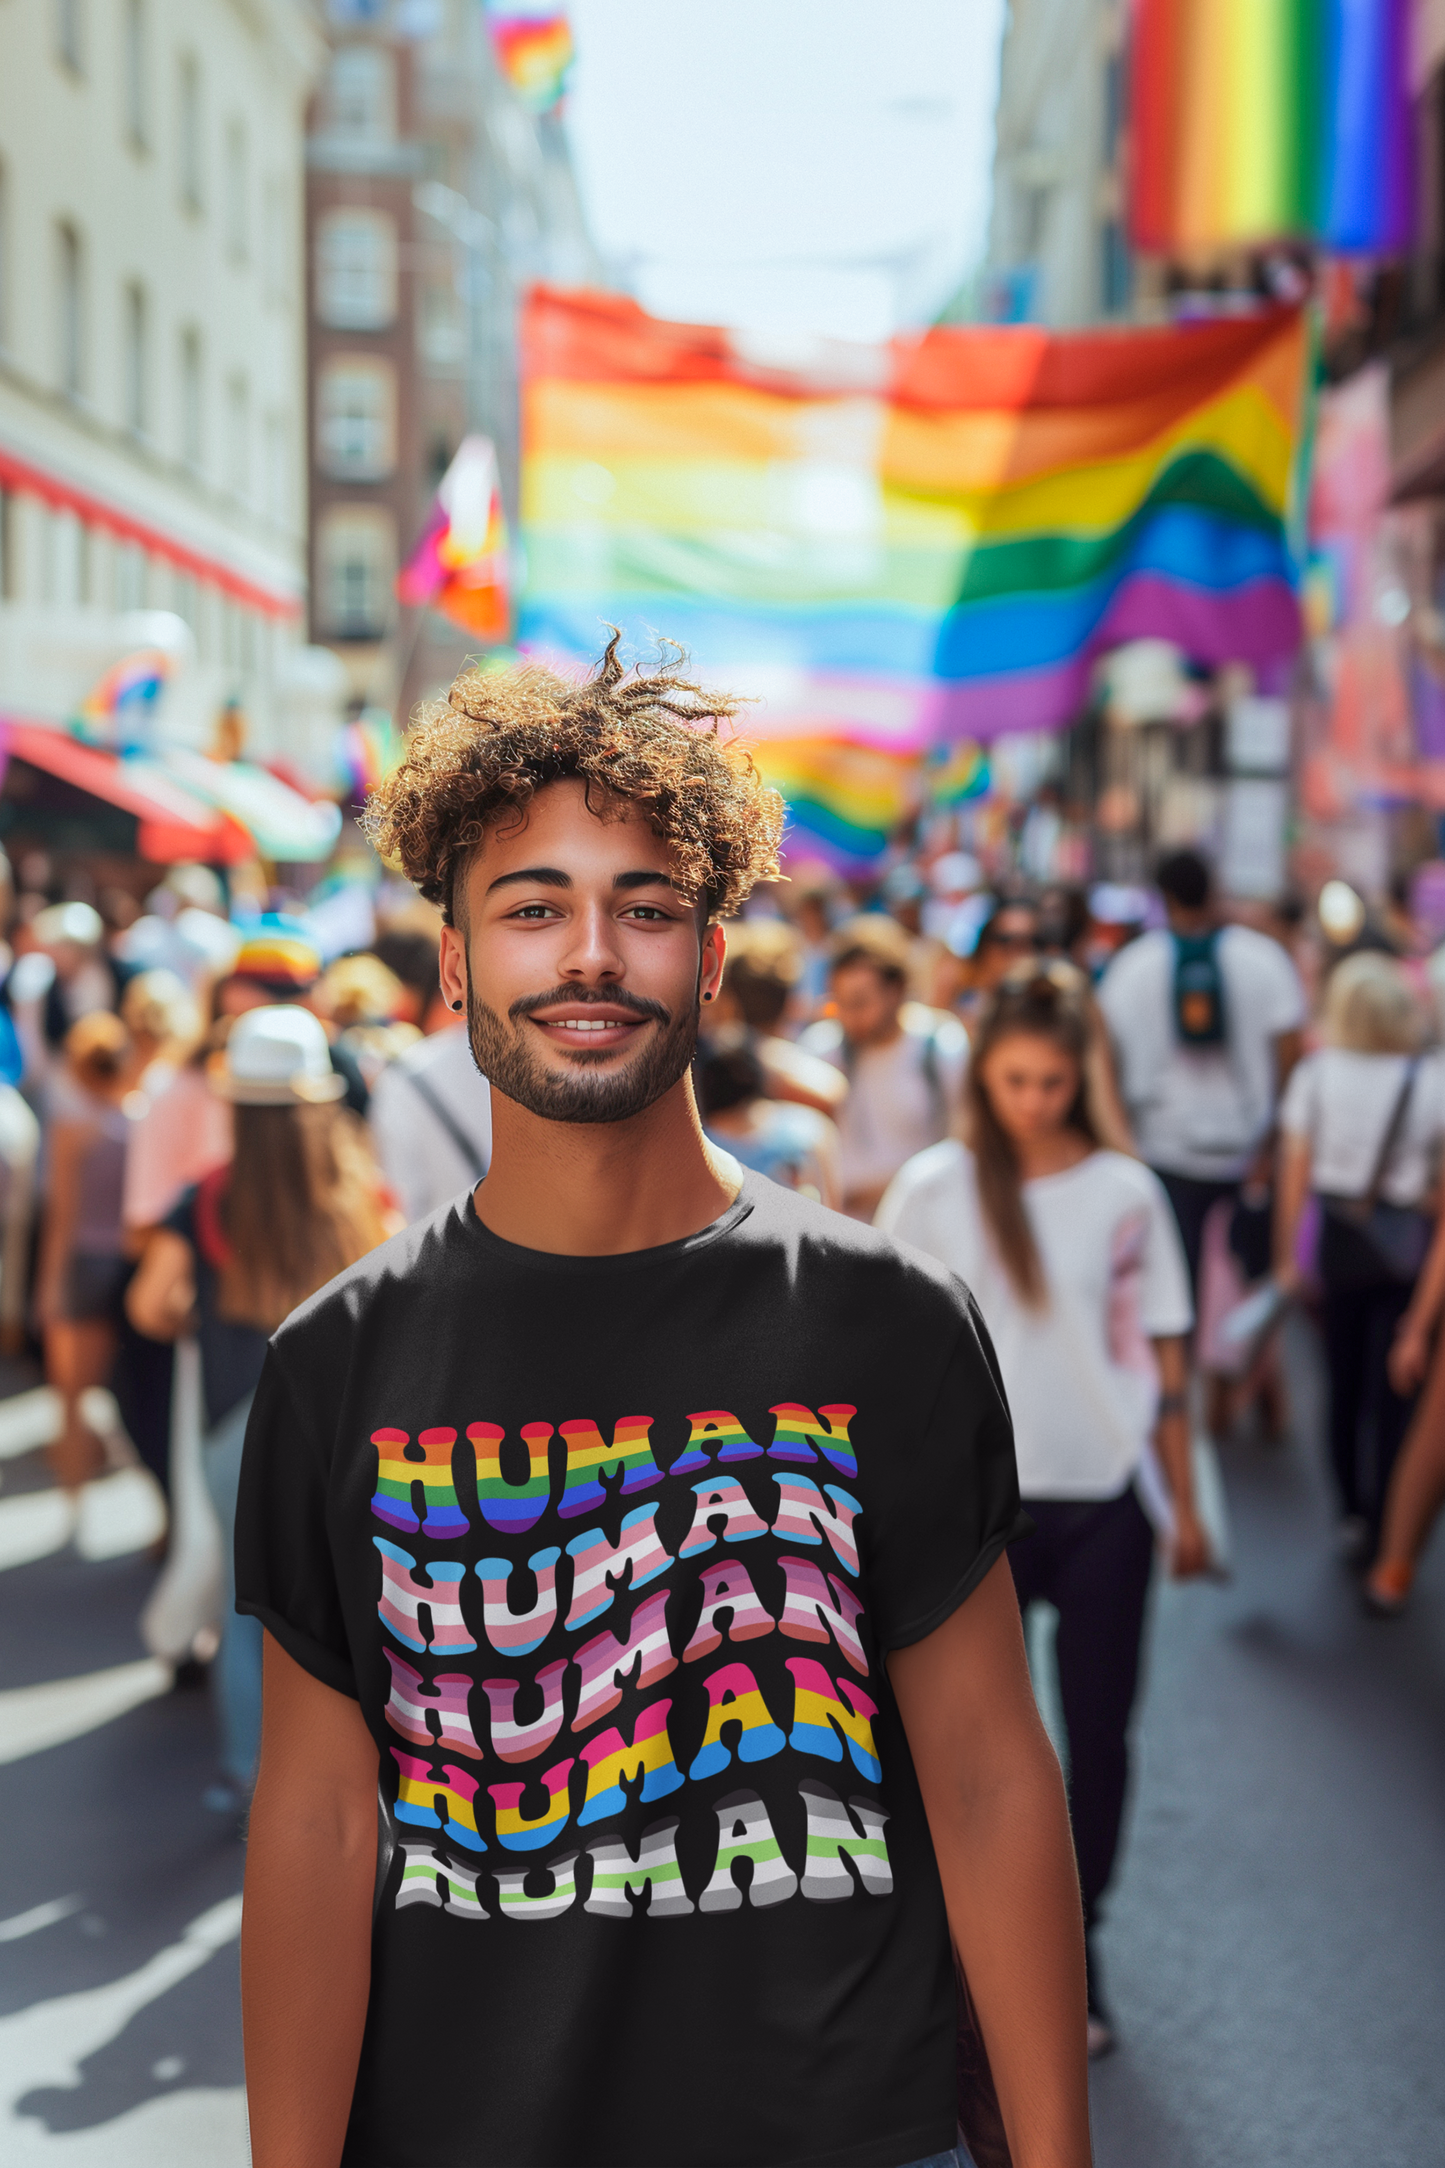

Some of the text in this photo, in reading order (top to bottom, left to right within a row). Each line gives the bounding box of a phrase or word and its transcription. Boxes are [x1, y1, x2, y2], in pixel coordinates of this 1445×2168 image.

[370, 1402, 858, 1539] HUMAN
[372, 1472, 863, 1656] HUMAN
[382, 1556, 869, 1763] HUMAN
[389, 1656, 882, 1852] HUMAN
[395, 1778, 893, 1920] HUMAN
